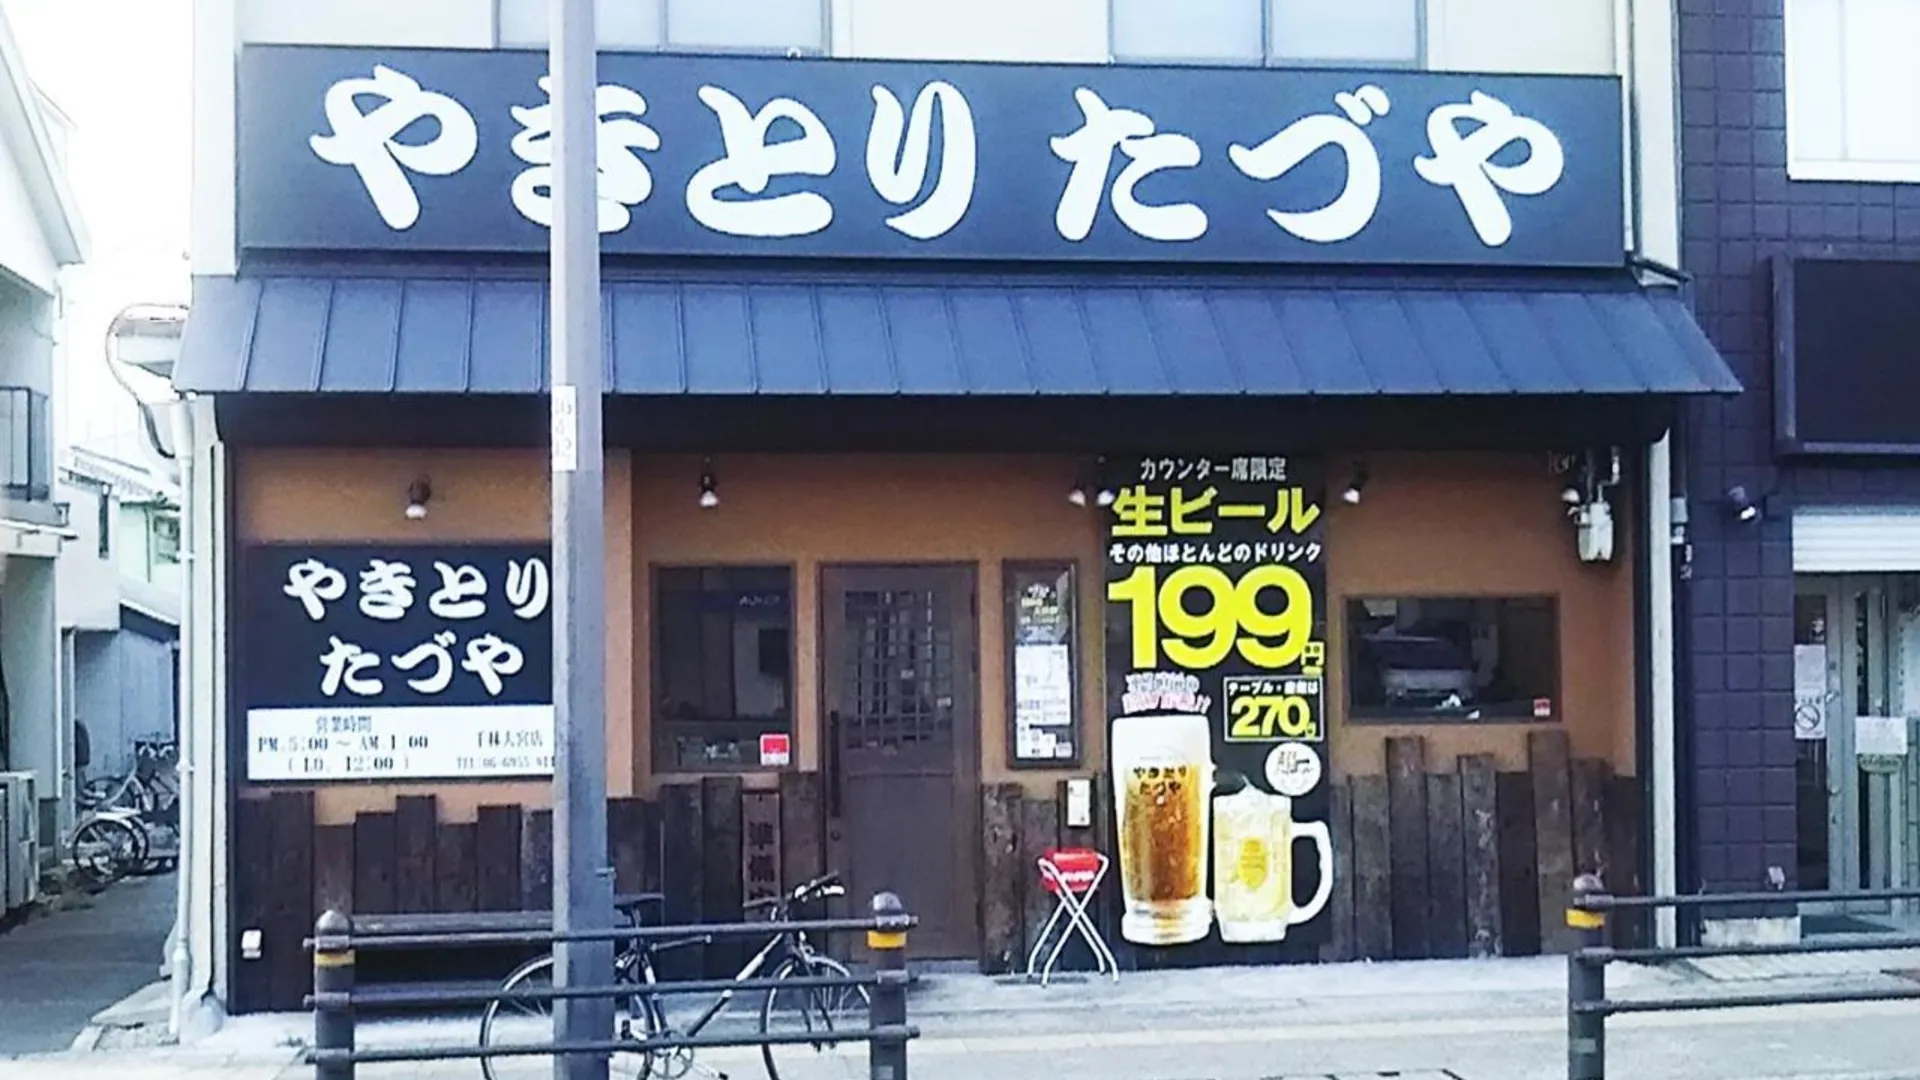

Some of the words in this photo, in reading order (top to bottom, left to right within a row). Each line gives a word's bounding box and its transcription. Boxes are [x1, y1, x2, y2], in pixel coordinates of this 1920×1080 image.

[309, 64, 977, 240] やきとり
[1050, 84, 1565, 249] たづや
[1140, 457, 1287, 481] カウンター席限定
[1111, 485, 1321, 537] 生ビール
[1109, 541, 1322, 564] その他ほとんどのドリンク
[283, 557, 550, 620] やきとり
[319, 630, 525, 697] たづや
[315, 715, 373, 734] 営業時間
